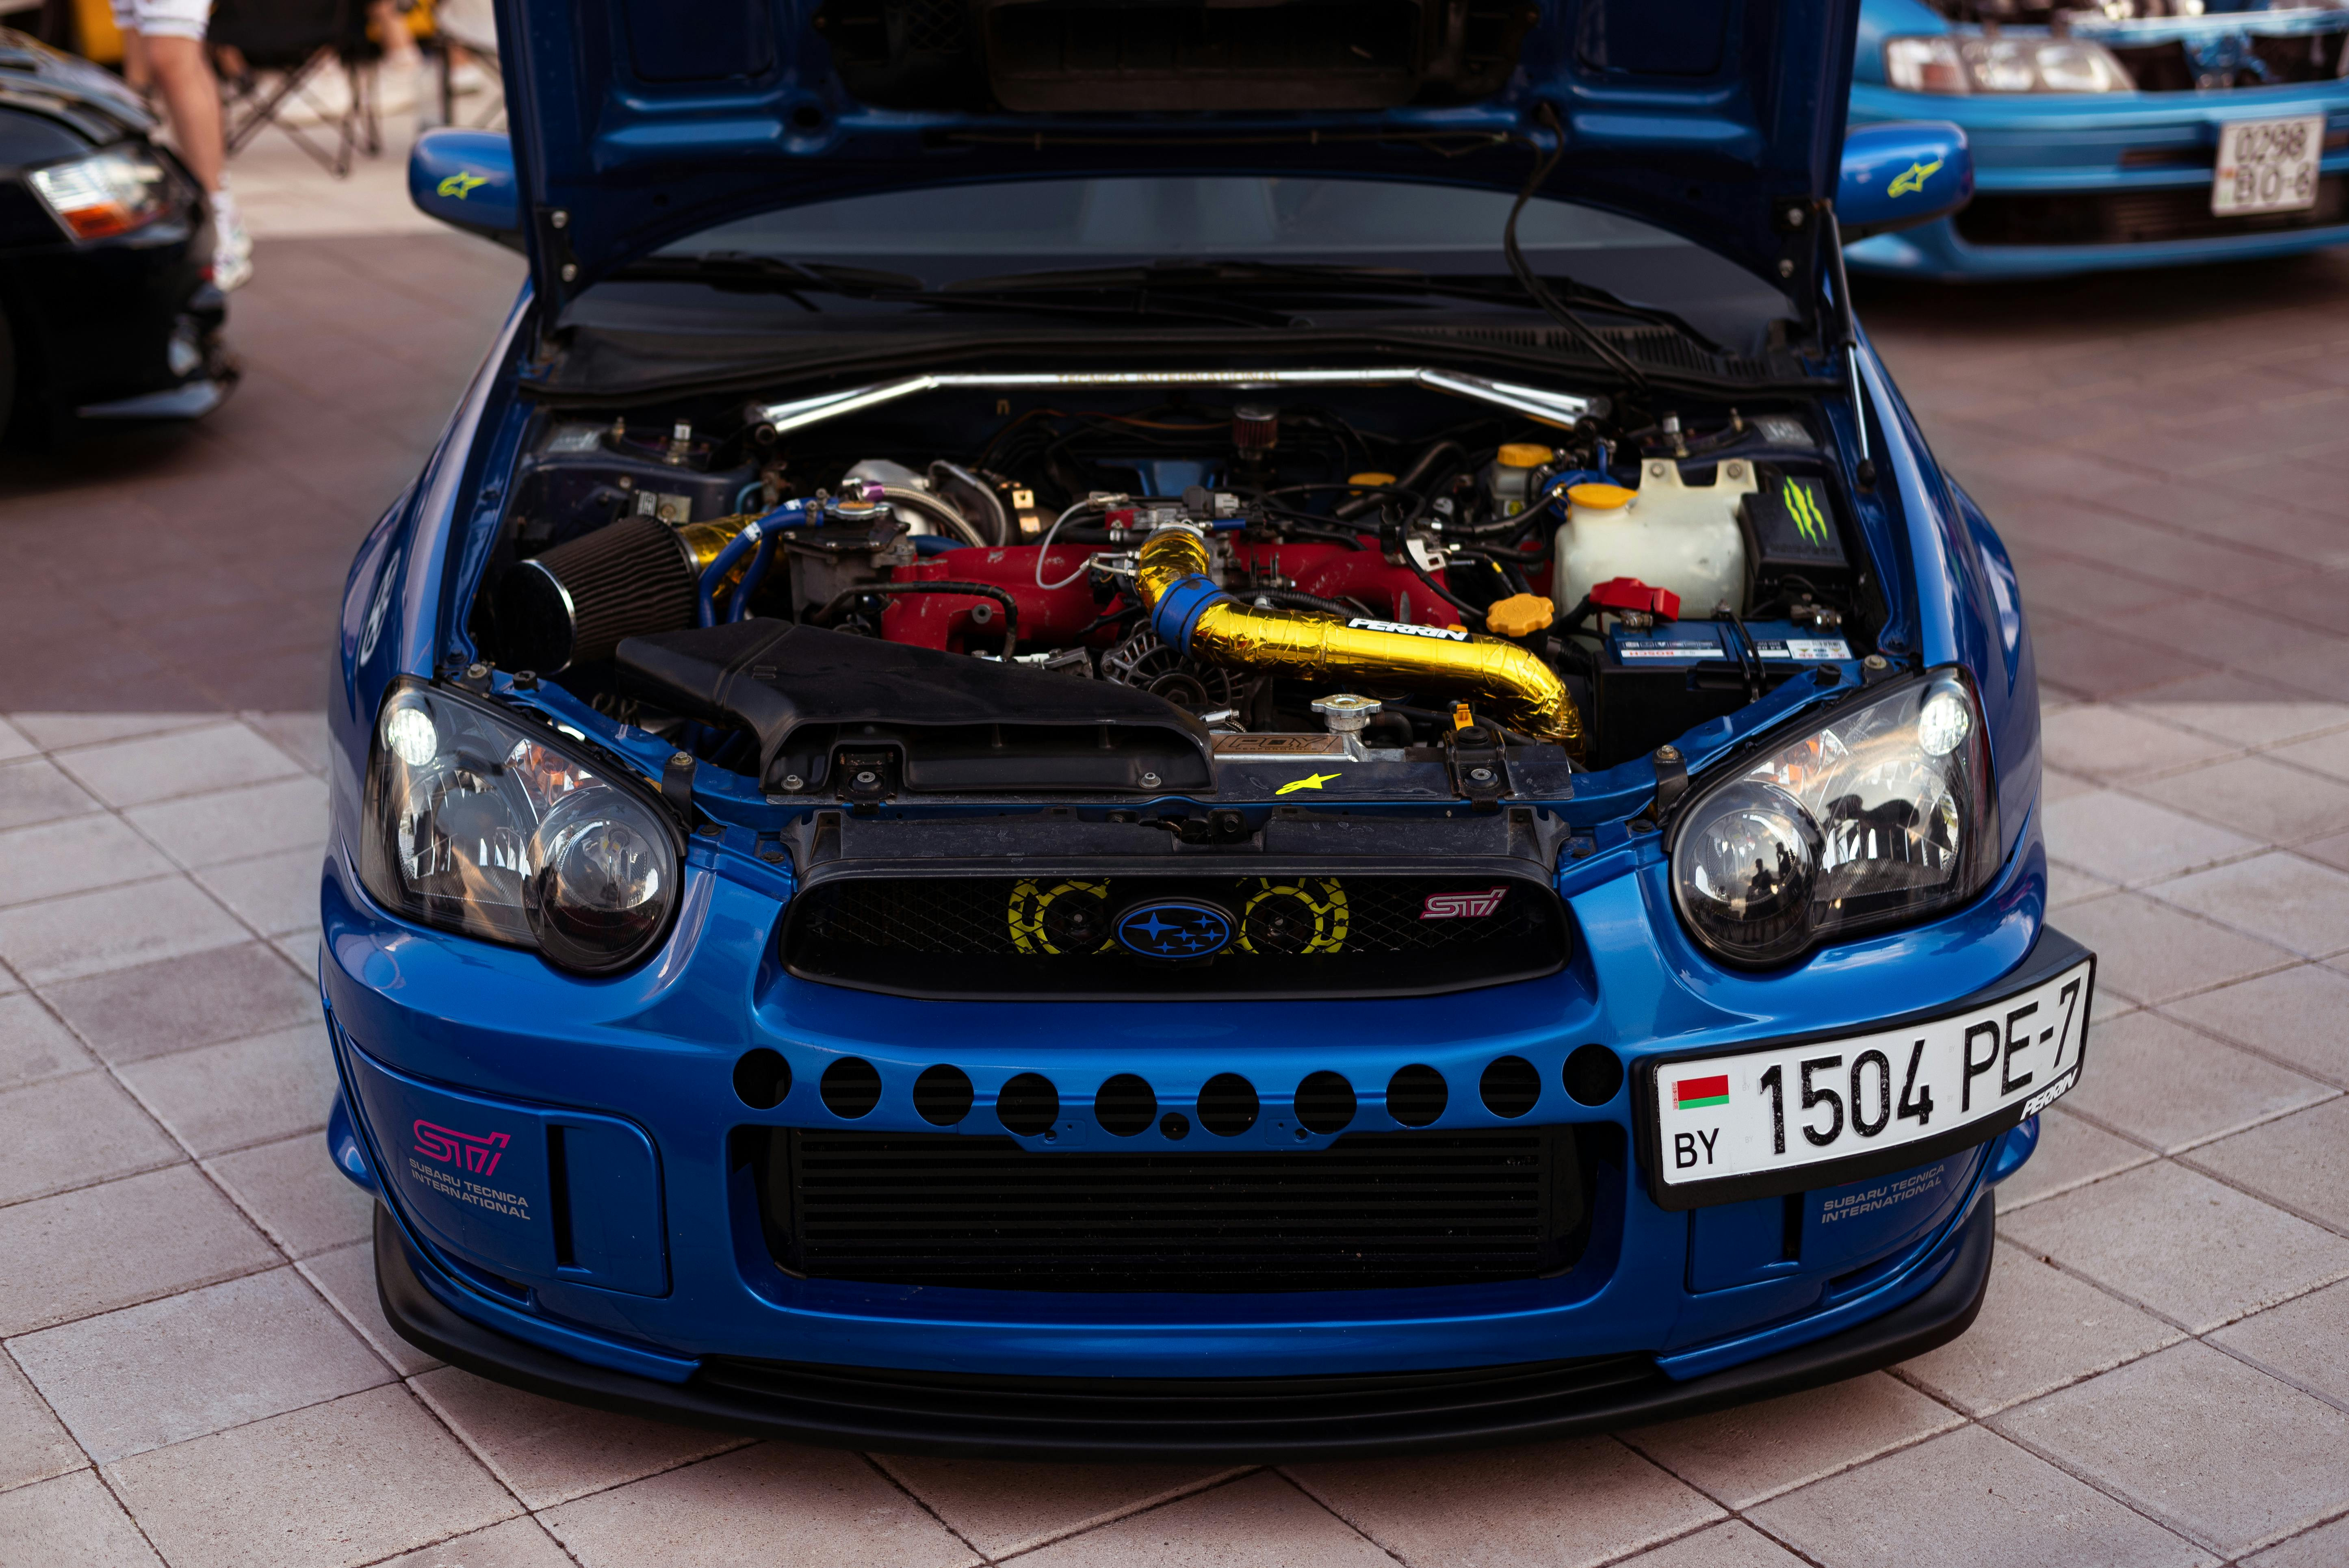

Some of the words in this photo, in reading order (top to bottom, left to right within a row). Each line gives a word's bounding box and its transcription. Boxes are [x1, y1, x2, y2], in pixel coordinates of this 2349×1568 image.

[2235, 123, 2308, 164] 0298
[1348, 618, 1468, 641] PERRIN
[1229, 737, 1328, 748] PQY
[1759, 1038, 1934, 1155] 1504
[1961, 977, 2080, 1113] PE-7
[2020, 1066, 2078, 1121] PERRIN
[1675, 1128, 1719, 1168] BY
[409, 1157, 461, 1187] SUBARU
[463, 1180, 529, 1208] TECNICA
[411, 1169, 531, 1220] INTERNATIONAL
[1821, 1176, 1942, 1224] INTERNATIONAL
[1824, 1186, 1887, 1211] SUBARU
[1891, 1164, 1944, 1193] TECNICA
